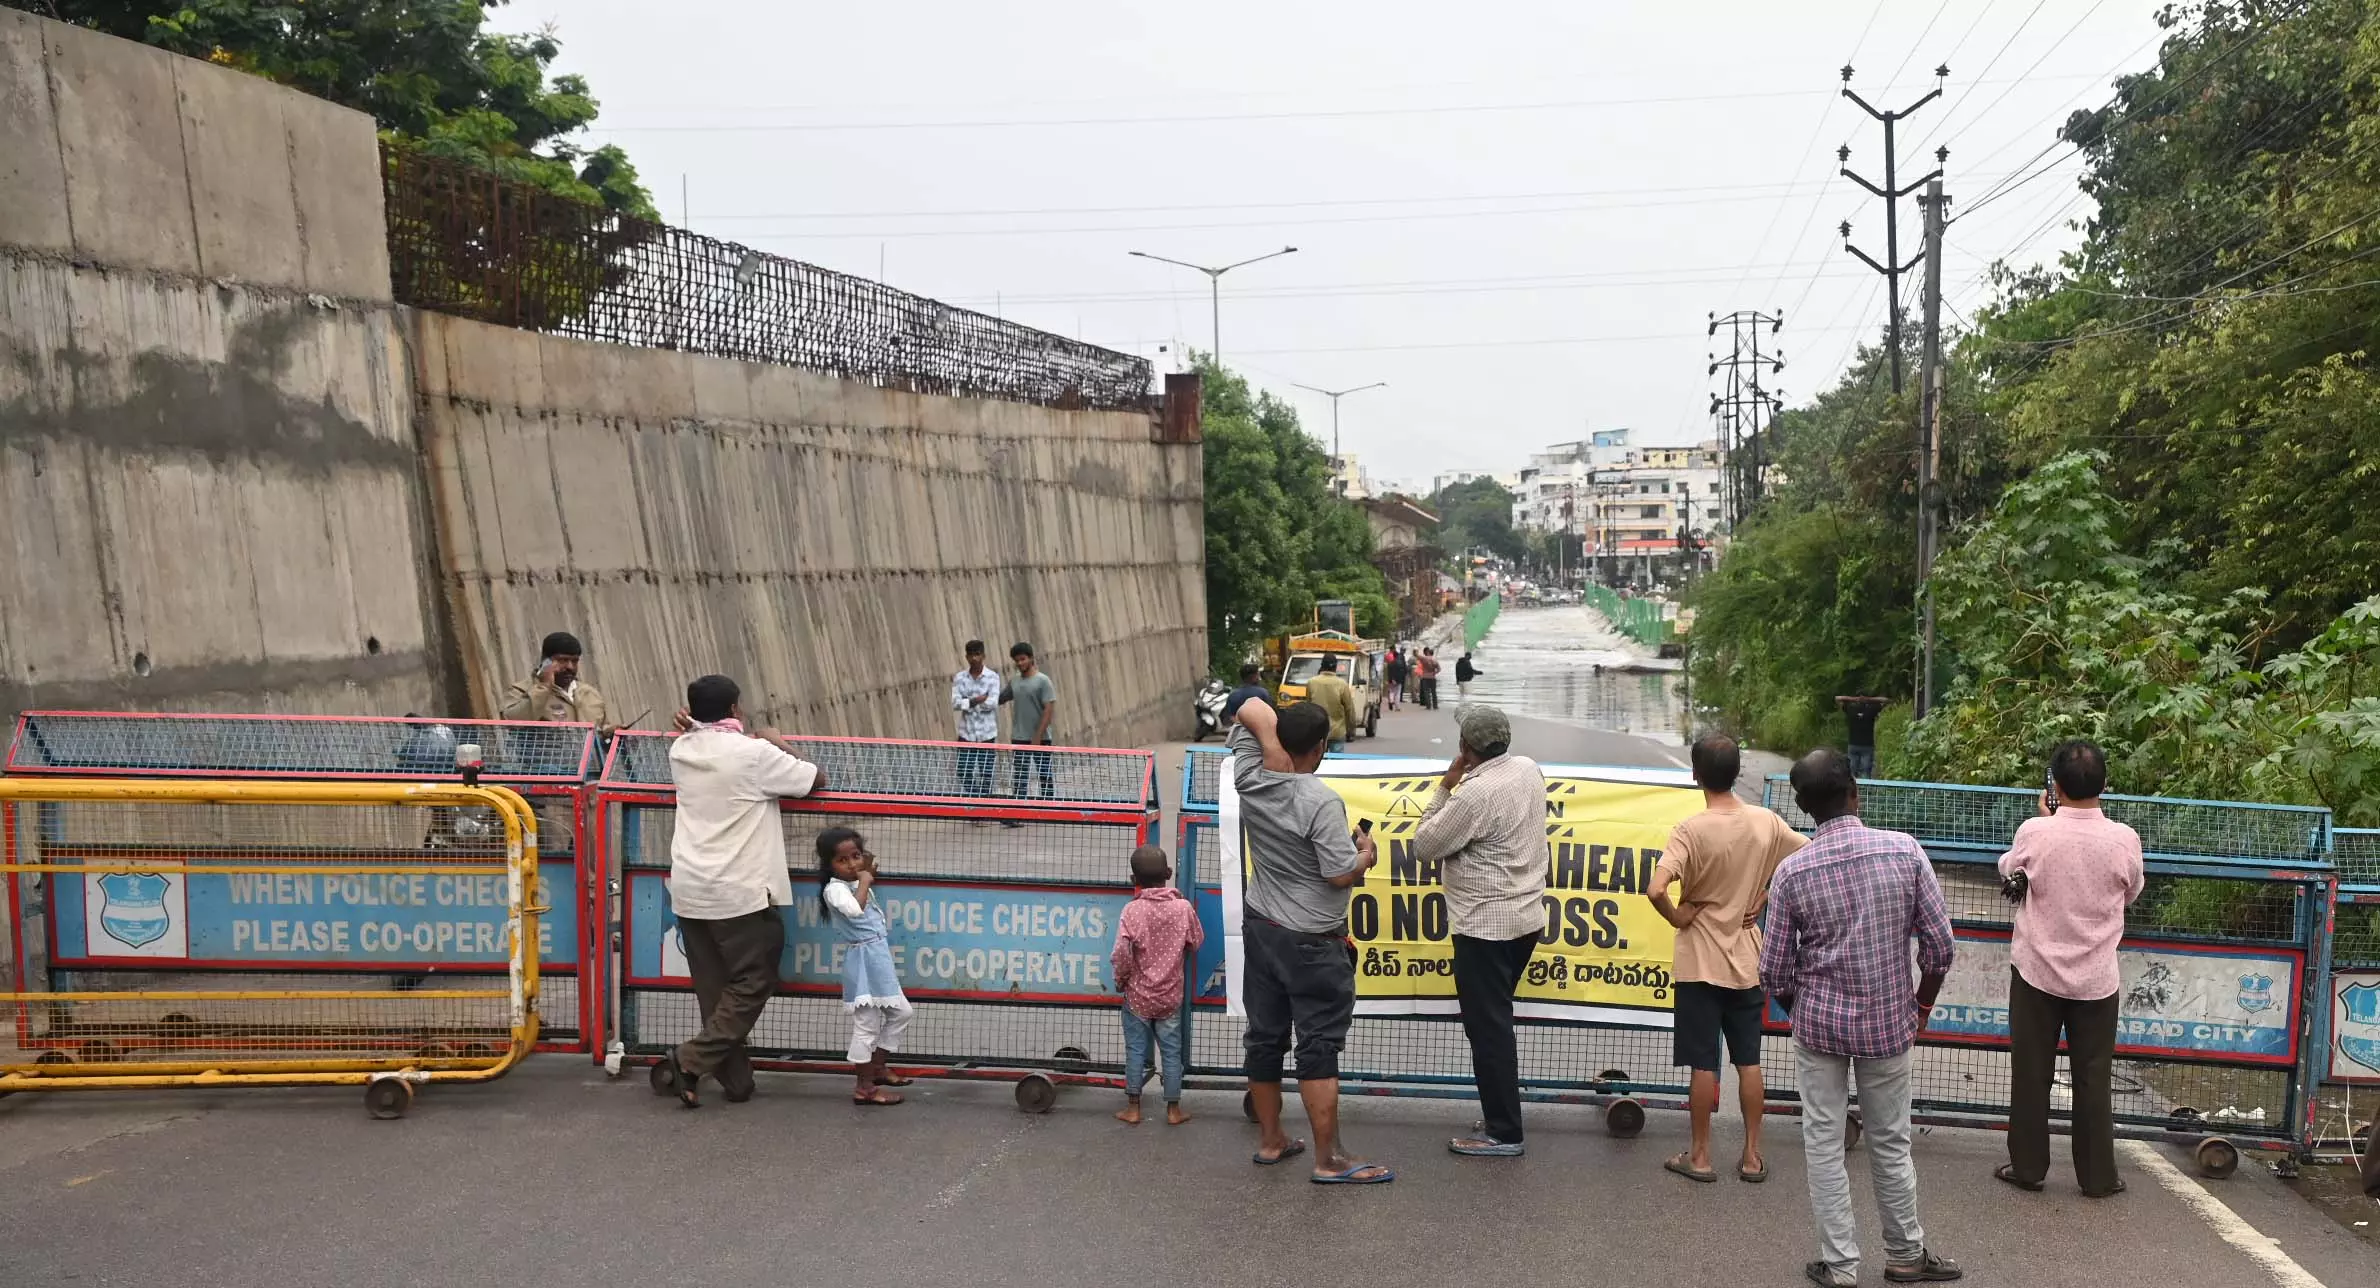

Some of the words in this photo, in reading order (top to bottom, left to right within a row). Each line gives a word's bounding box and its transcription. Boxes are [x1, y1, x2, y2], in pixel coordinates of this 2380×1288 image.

[229, 873, 313, 905] WHEN
[323, 874, 427, 906] POLICE
[435, 875, 551, 908] CHECS
[232, 919, 350, 952] PLEASE
[359, 920, 553, 953] CO-OPERAE
[886, 899, 985, 934] POLICE
[992, 903, 1102, 938] CHECKS
[1347, 893, 1378, 942] O
[1391, 892, 1450, 942] NO
[1537, 895, 1629, 950] OSS.
[795, 942, 905, 977] PLEE
[915, 946, 1101, 986] CO-OPERATE
[1362, 947, 1402, 977] డీప్
[1406, 958, 1455, 977] నాల
[1929, 1005, 2010, 1026] OLICE
[2192, 1024, 2257, 1043] CITY
